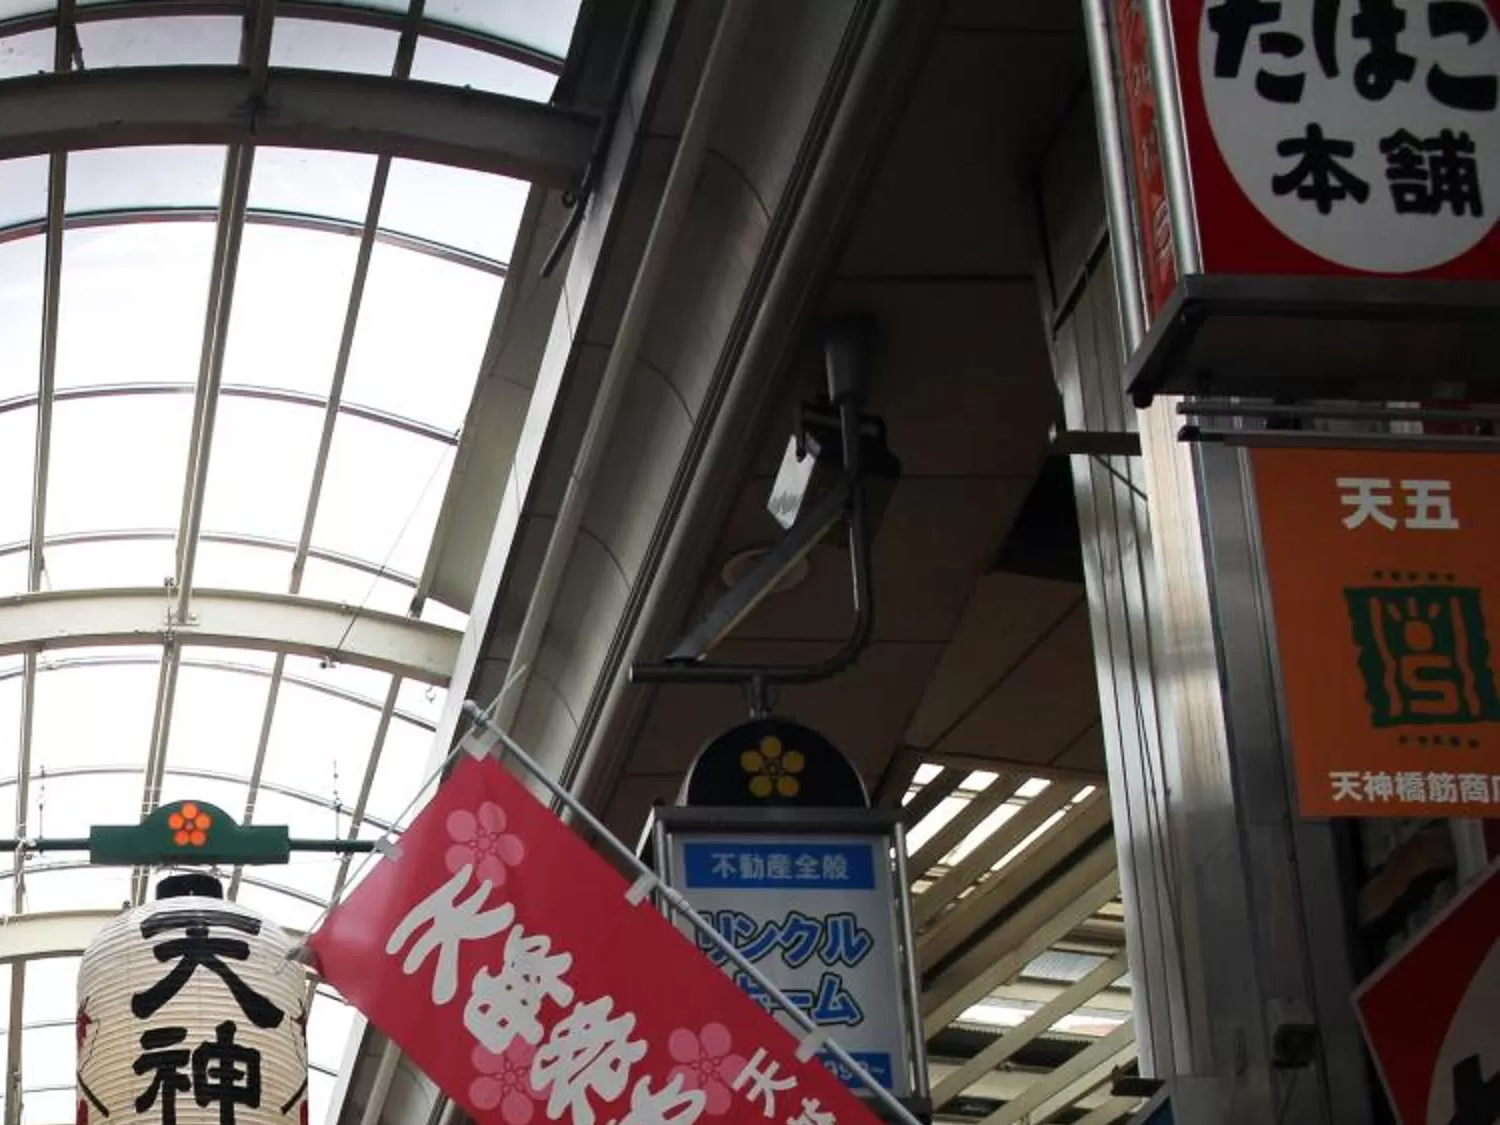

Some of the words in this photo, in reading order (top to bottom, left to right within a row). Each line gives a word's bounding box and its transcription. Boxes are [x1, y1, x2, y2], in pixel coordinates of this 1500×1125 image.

[1272, 123, 1484, 217] 本舗
[1336, 477, 1460, 531] 天五
[711, 852, 850, 880] 不動産全般
